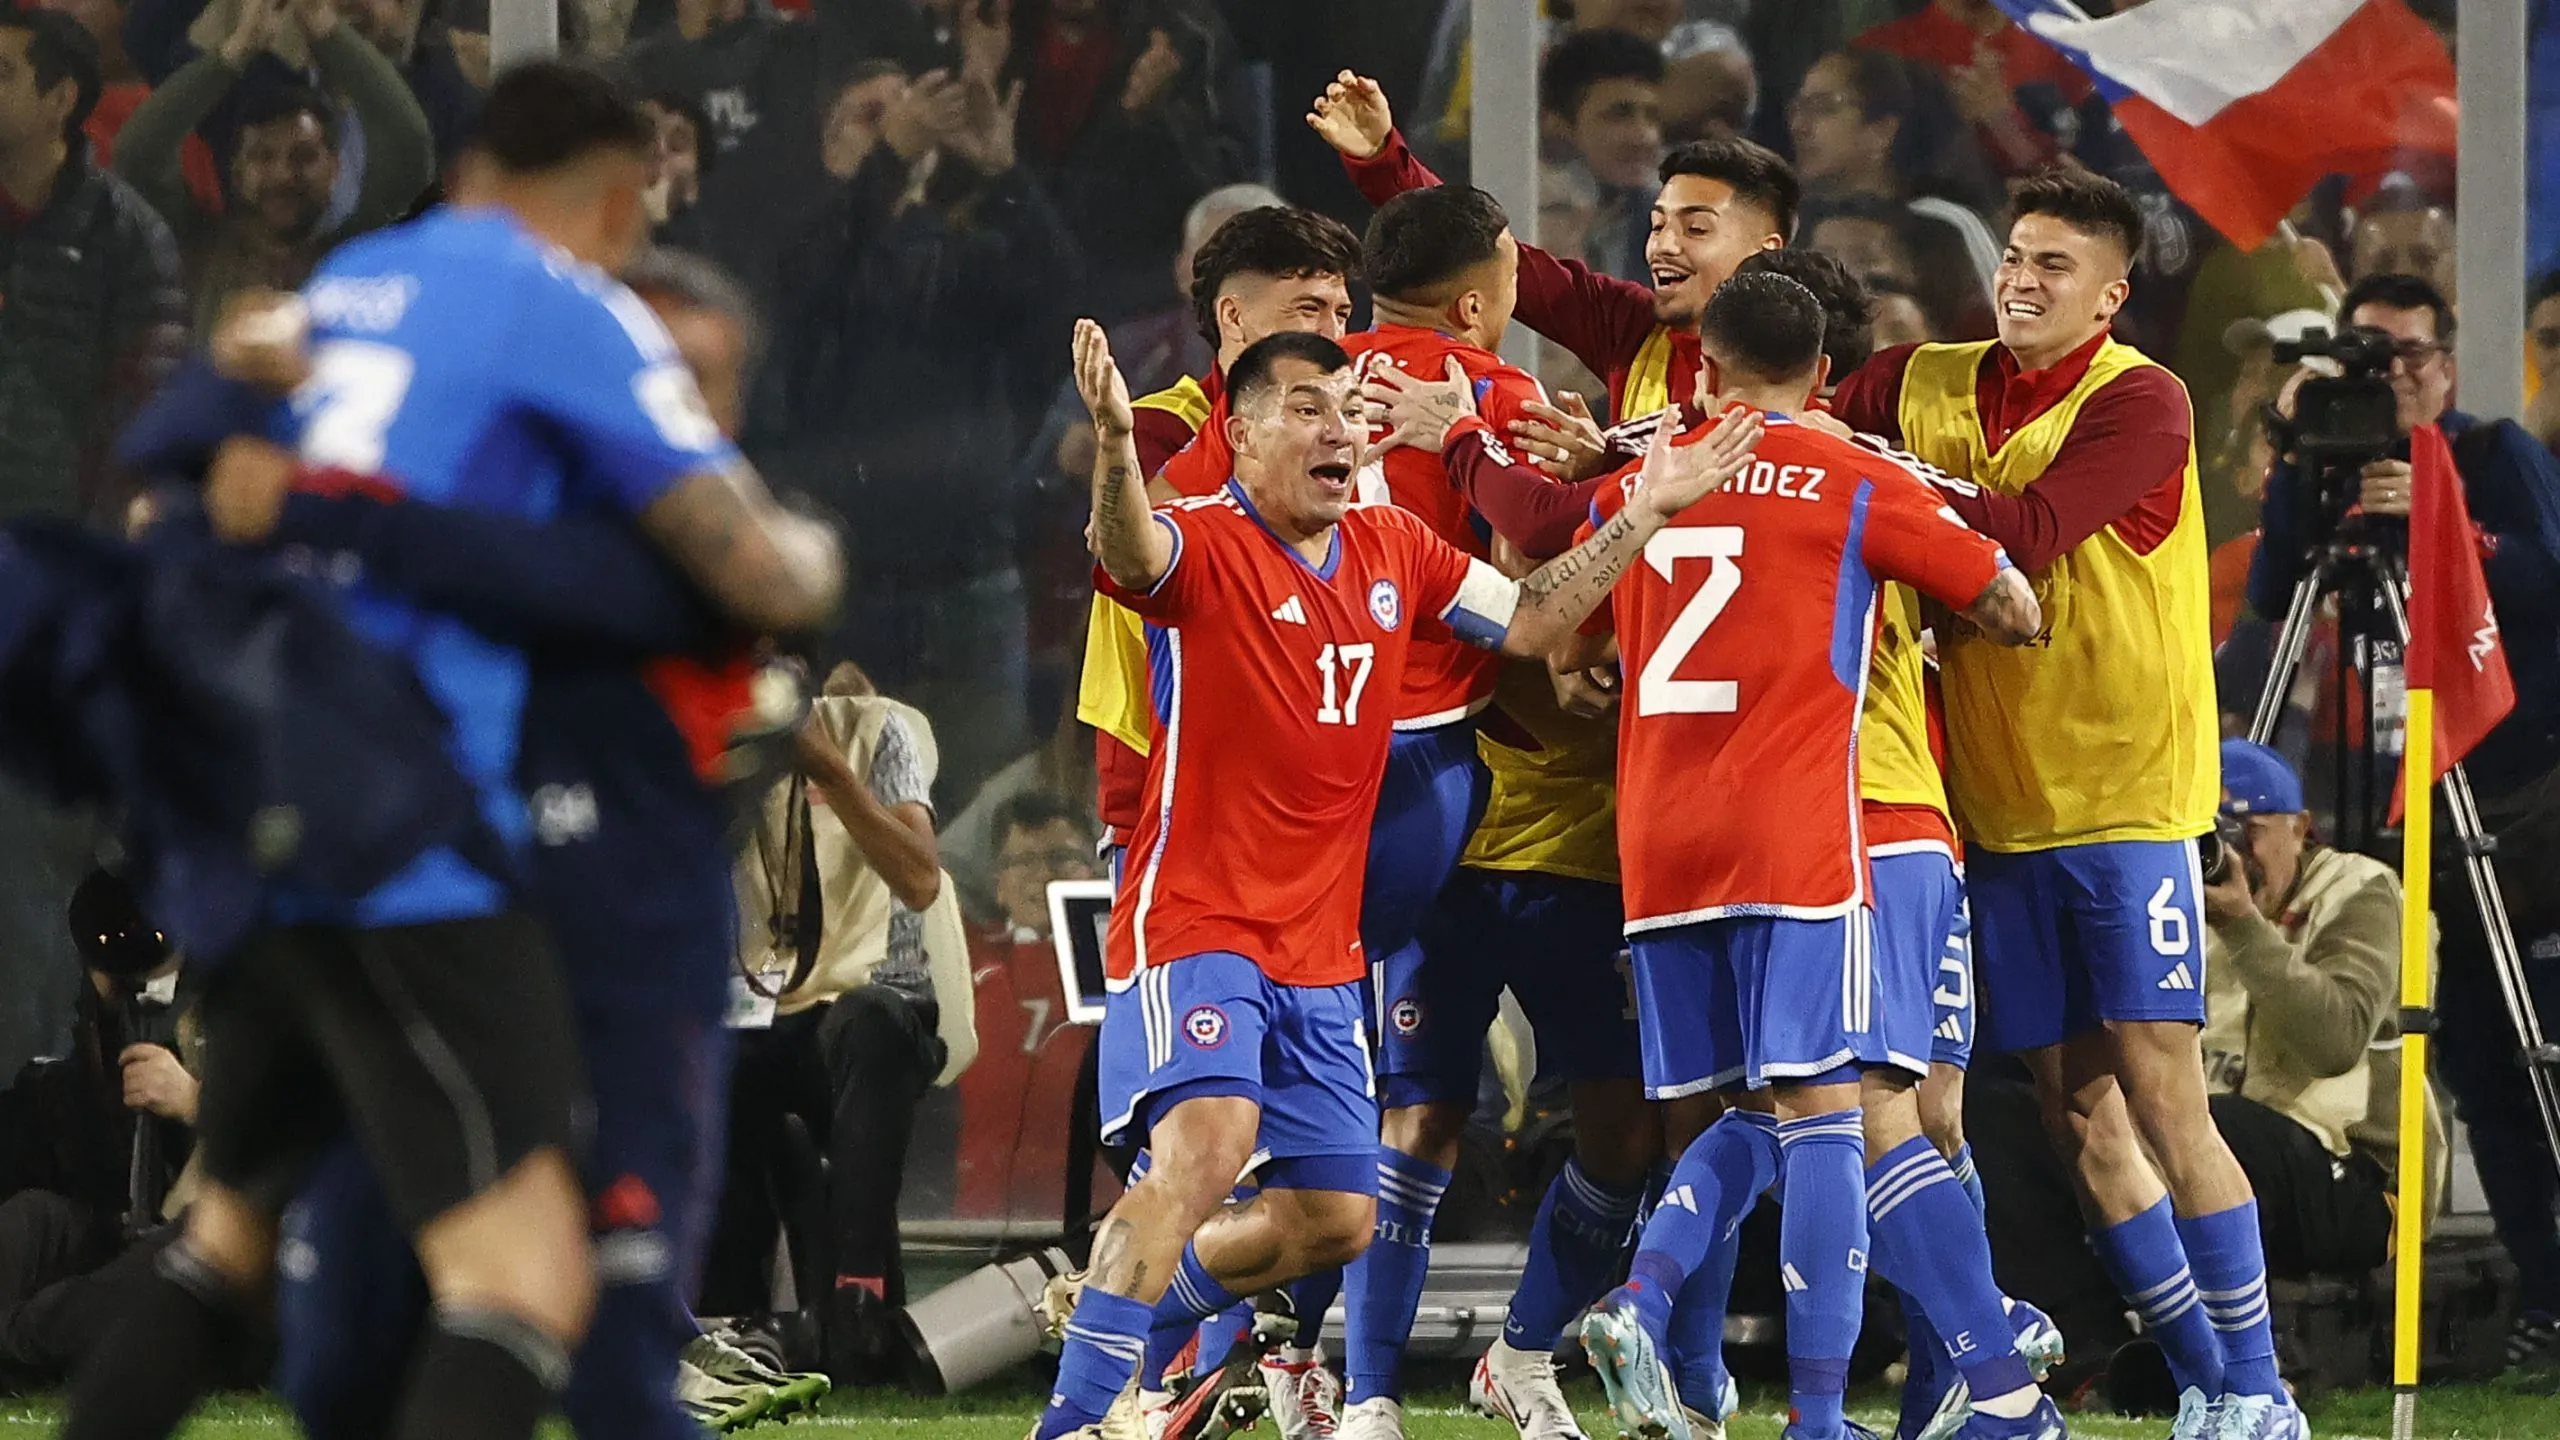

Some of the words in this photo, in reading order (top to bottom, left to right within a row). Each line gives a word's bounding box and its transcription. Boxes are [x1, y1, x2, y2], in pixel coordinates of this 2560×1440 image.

[1638, 525, 1744, 718] 2
[1315, 642, 1375, 726] 17
[2147, 877, 2190, 955] 6
[1022, 998, 1050, 1052] 7
[1373, 1219, 1431, 1250] HILE
